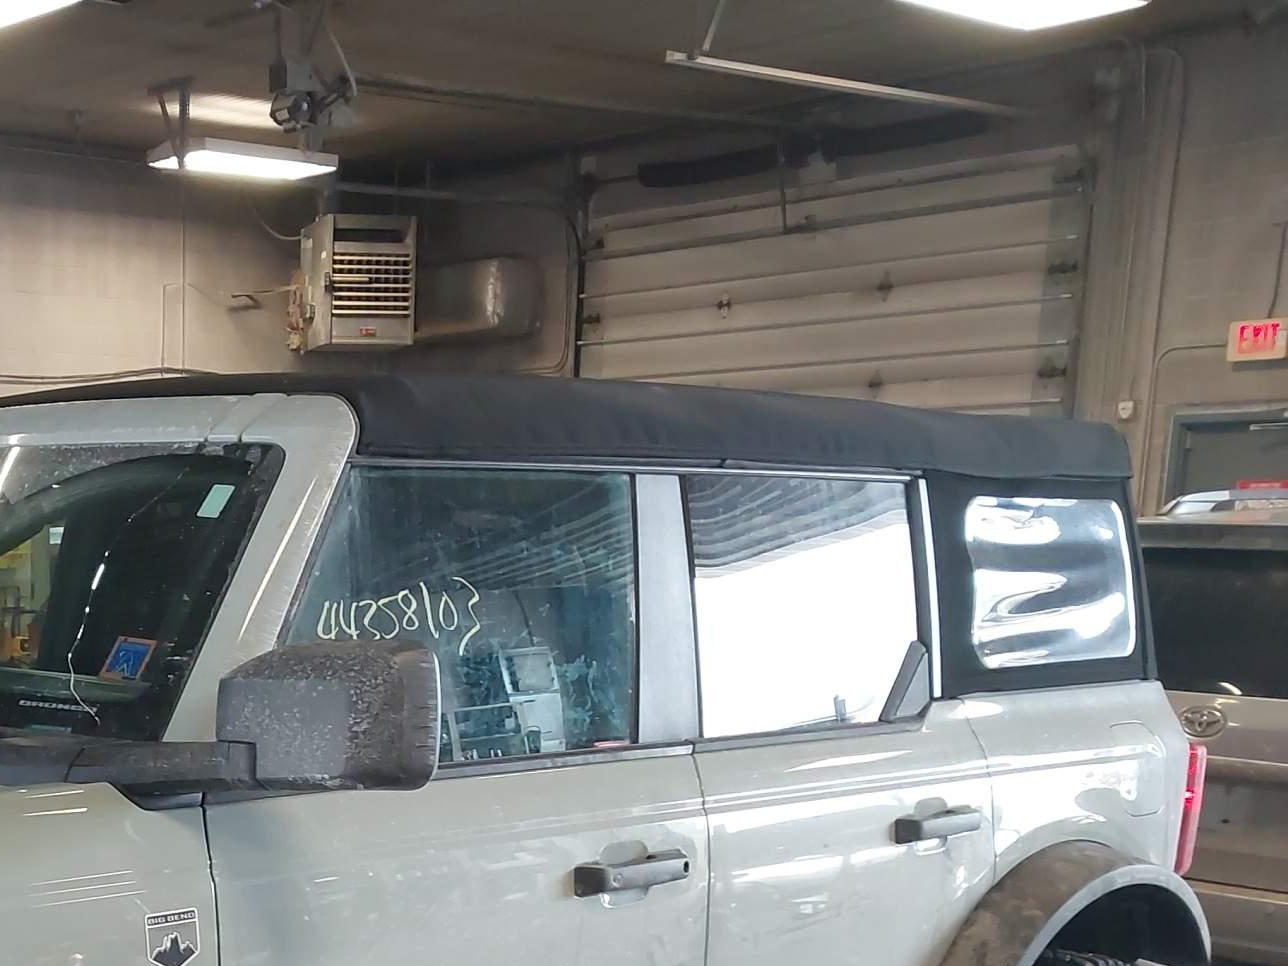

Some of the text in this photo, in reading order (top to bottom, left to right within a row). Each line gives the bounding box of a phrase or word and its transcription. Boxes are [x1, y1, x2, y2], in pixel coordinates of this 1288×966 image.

[1238, 322, 1281, 353] EXIT
[317, 576, 481, 656] 44358103
[18, 699, 97, 713] BRONCO
[147, 911, 195, 925] BIG BEND
